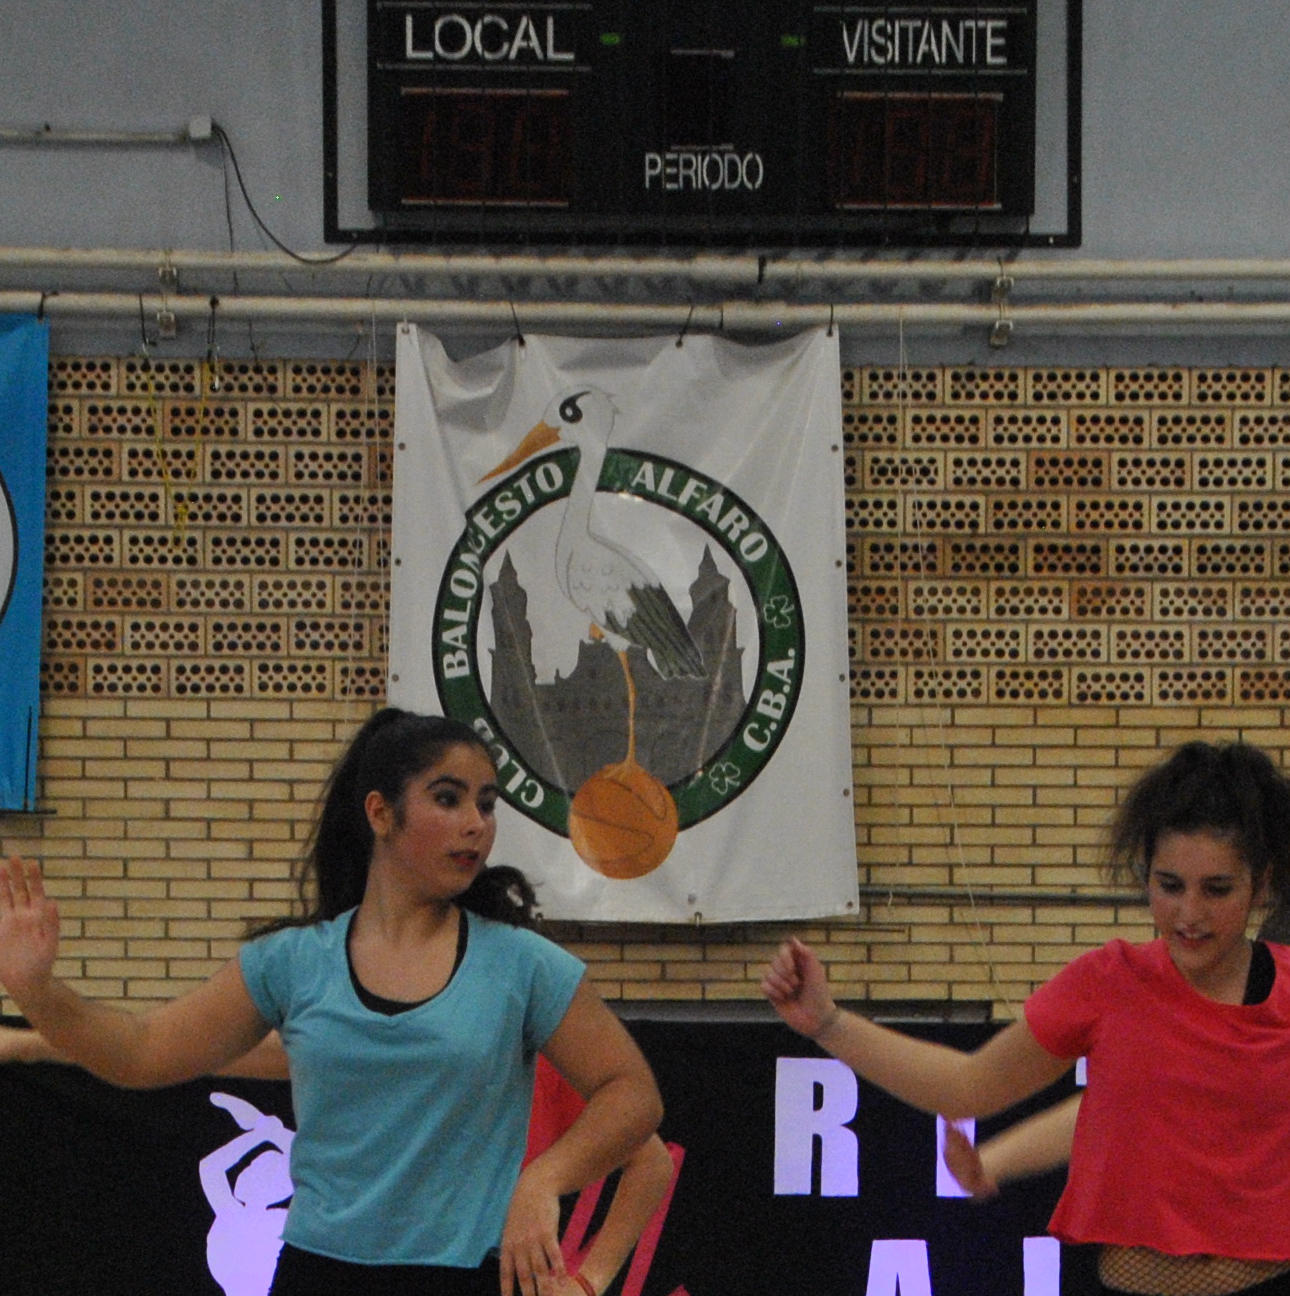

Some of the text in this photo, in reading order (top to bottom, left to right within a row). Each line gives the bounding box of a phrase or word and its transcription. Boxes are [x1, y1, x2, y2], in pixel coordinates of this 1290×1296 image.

[406, 15, 575, 61] LOCAL
[841, 19, 1008, 66] VISITANTE
[644, 152, 764, 190] PERIODO
[631, 461, 769, 563] ALFARO
[743, 648, 796, 752] C.B.A.
